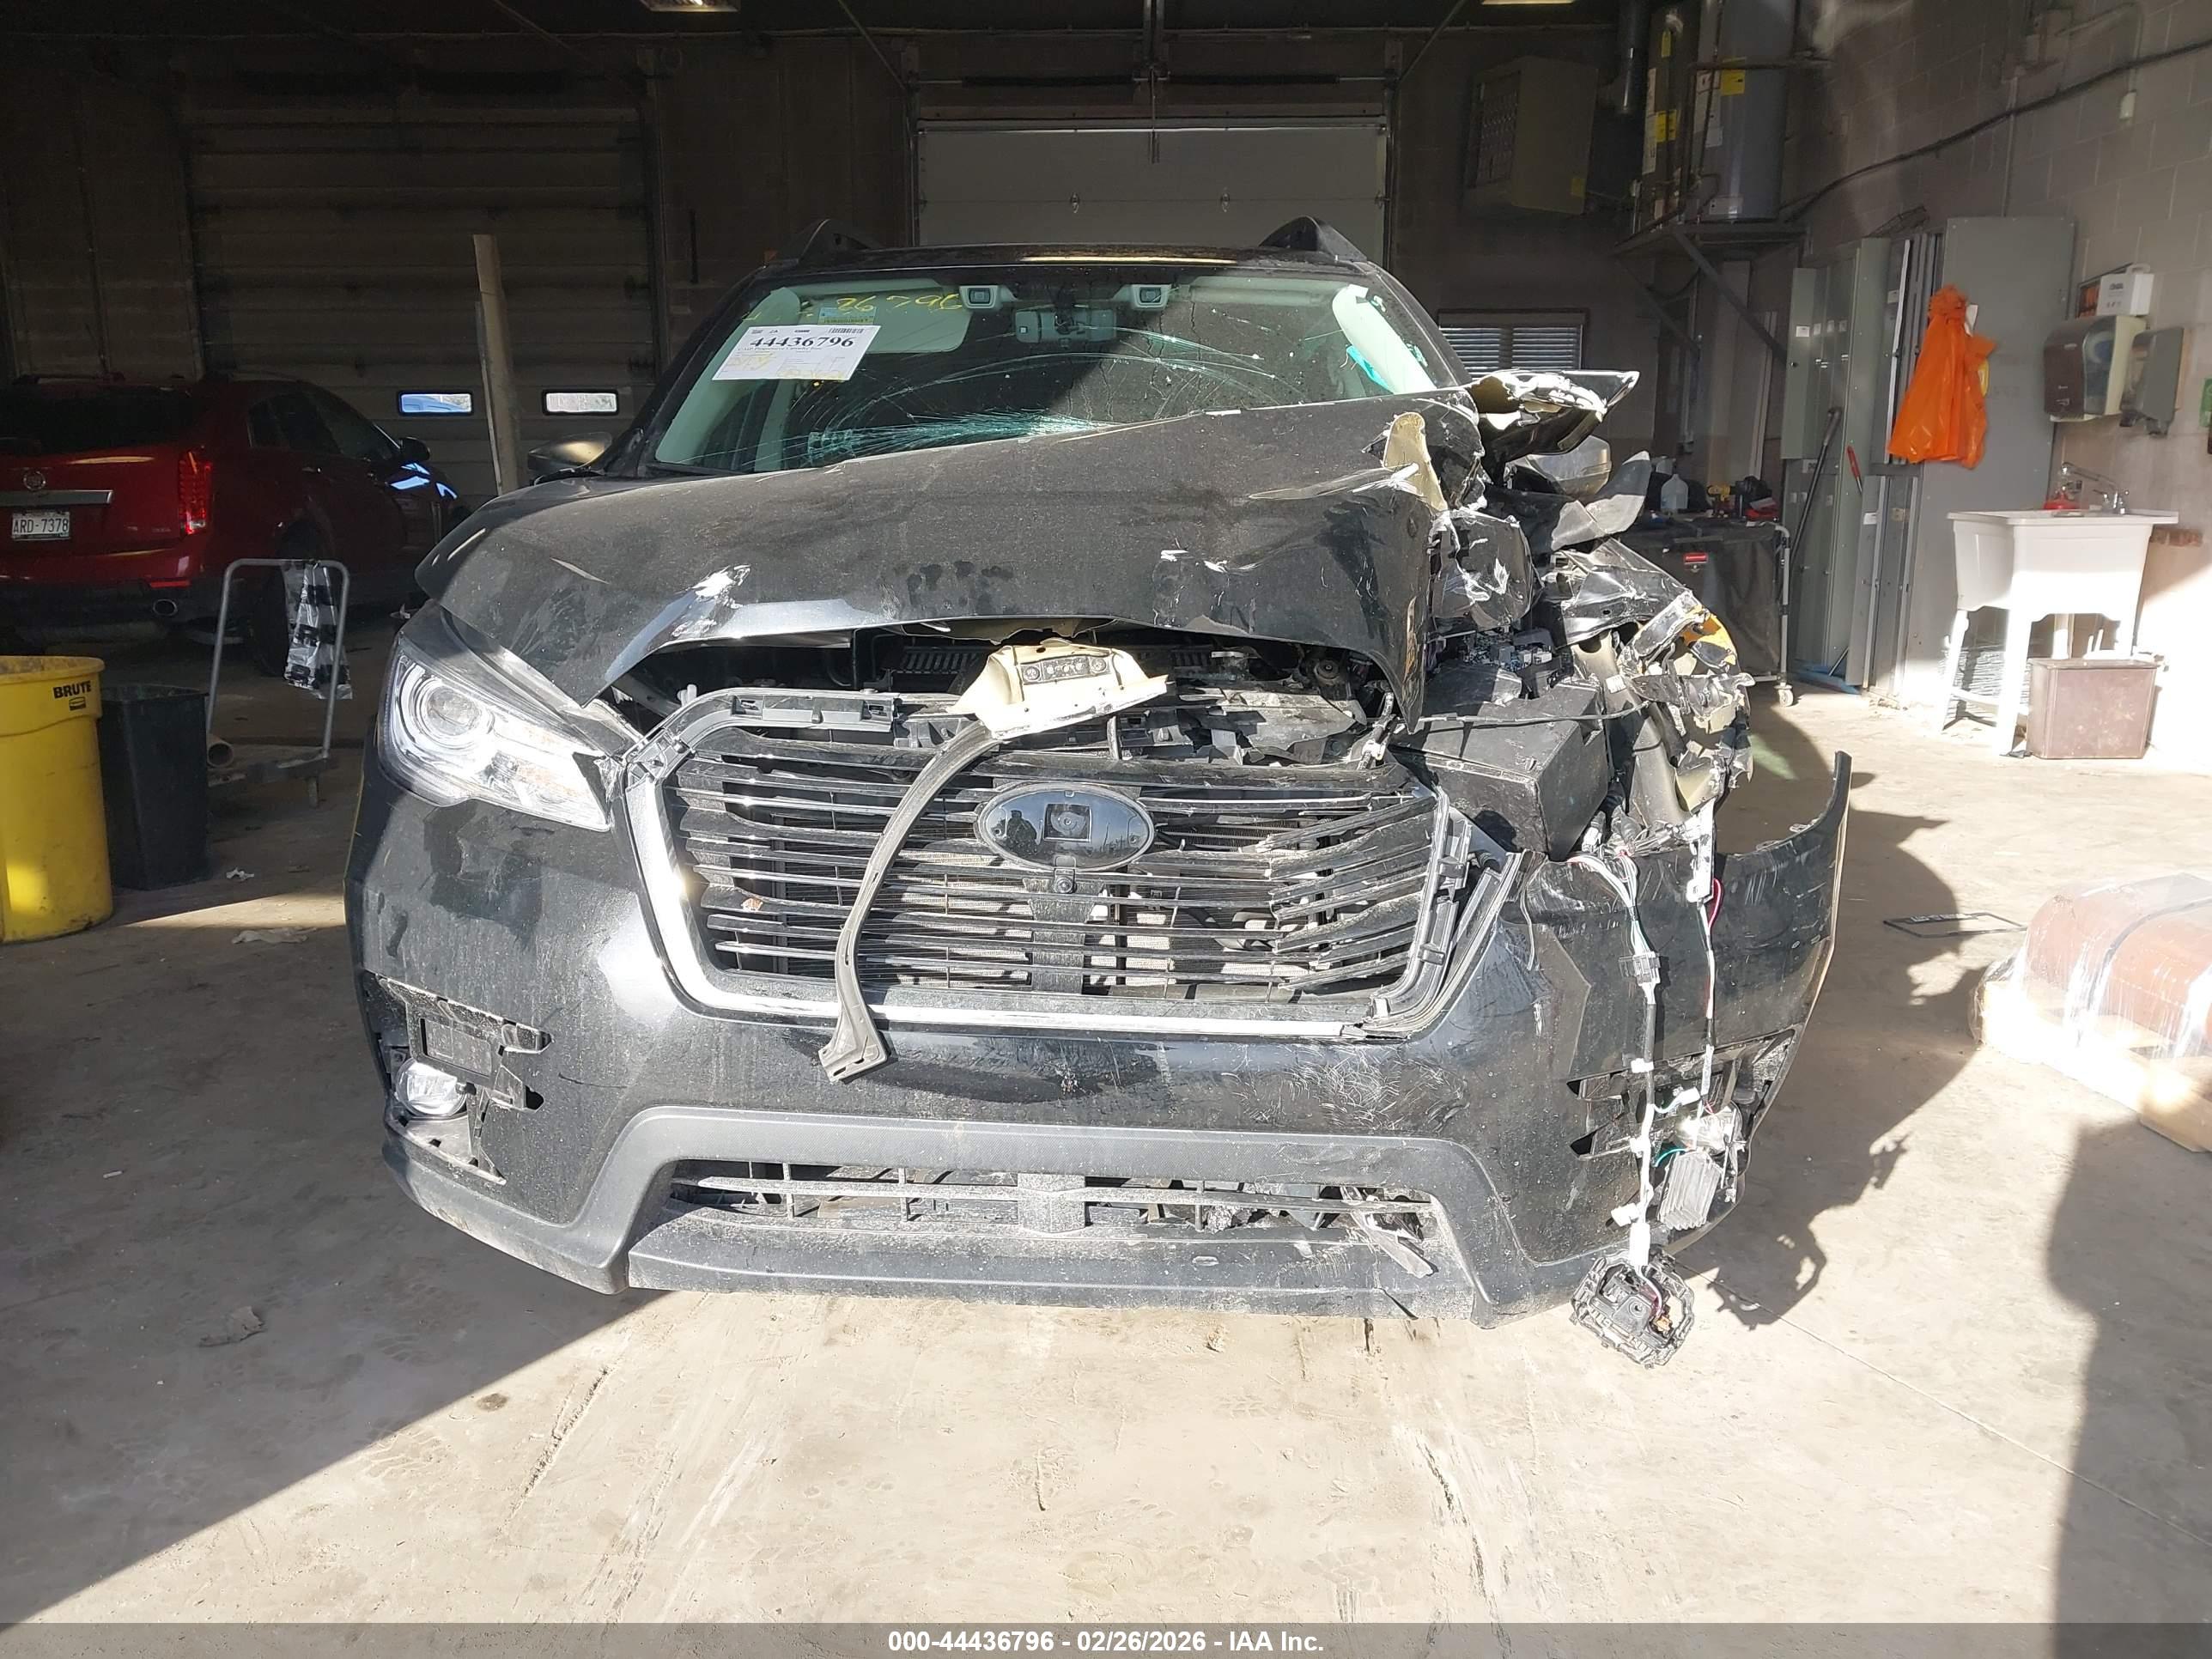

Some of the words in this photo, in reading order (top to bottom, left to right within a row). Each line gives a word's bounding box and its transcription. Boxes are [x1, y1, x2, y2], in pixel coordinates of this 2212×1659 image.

[750, 336, 857, 347] 44436796
[13, 518, 69, 533] ARD-7378
[52, 680, 92, 700] BRUTE
